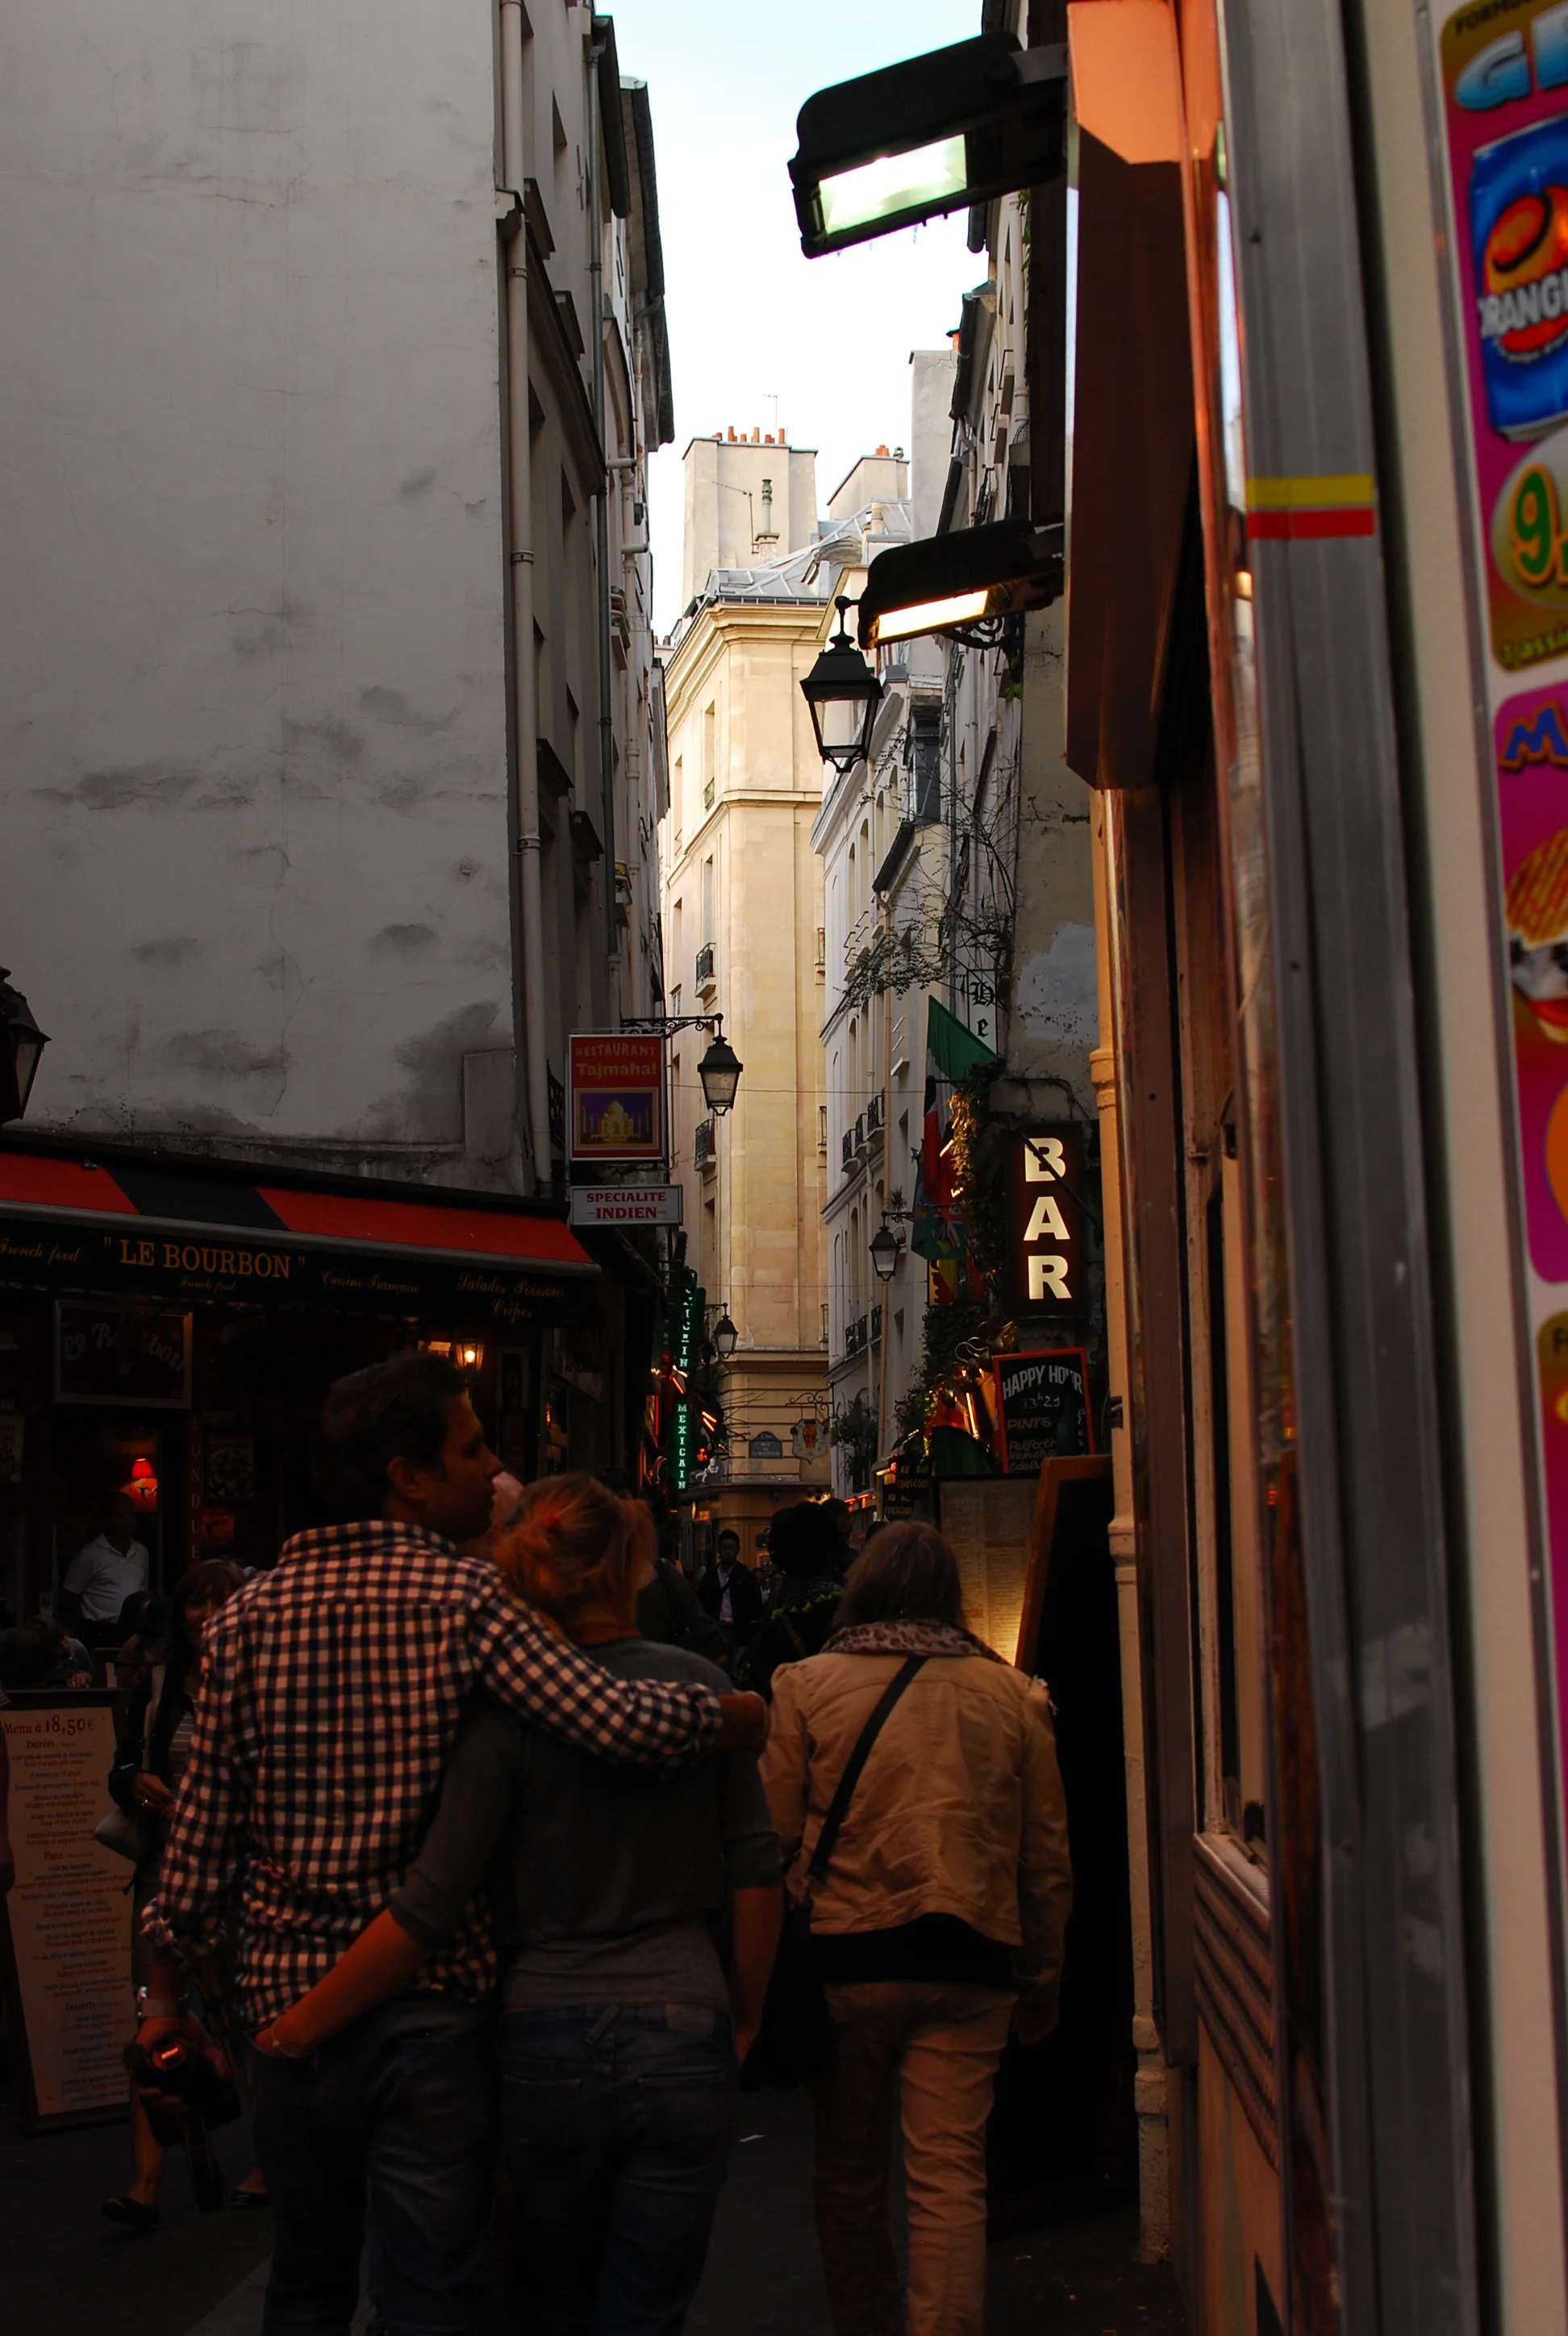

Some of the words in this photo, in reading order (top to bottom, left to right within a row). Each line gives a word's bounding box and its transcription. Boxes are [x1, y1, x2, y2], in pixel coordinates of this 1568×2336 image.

[575, 1042, 657, 1057] RESTAURANT
[575, 1062, 657, 1080] Tajmahal
[586, 1192, 666, 1203] SPECIALITE
[596, 1207, 657, 1219] INDIEN
[1024, 1137, 1073, 1300] BAR
[45, 1243, 81, 1267] food
[119, 1238, 155, 1267] LE
[162, 1243, 291, 1279] BOURBON
[321, 1269, 363, 1288] Cuisine
[457, 1270, 507, 1295] Salades
[1002, 1364, 1046, 1401] HAPPY
[677, 1404, 687, 1490] MEXICAIN
[4, 1723, 32, 1734] Menu
[35, 1721, 42, 1733] à
[27, 1739, 55, 1749] Entrées
